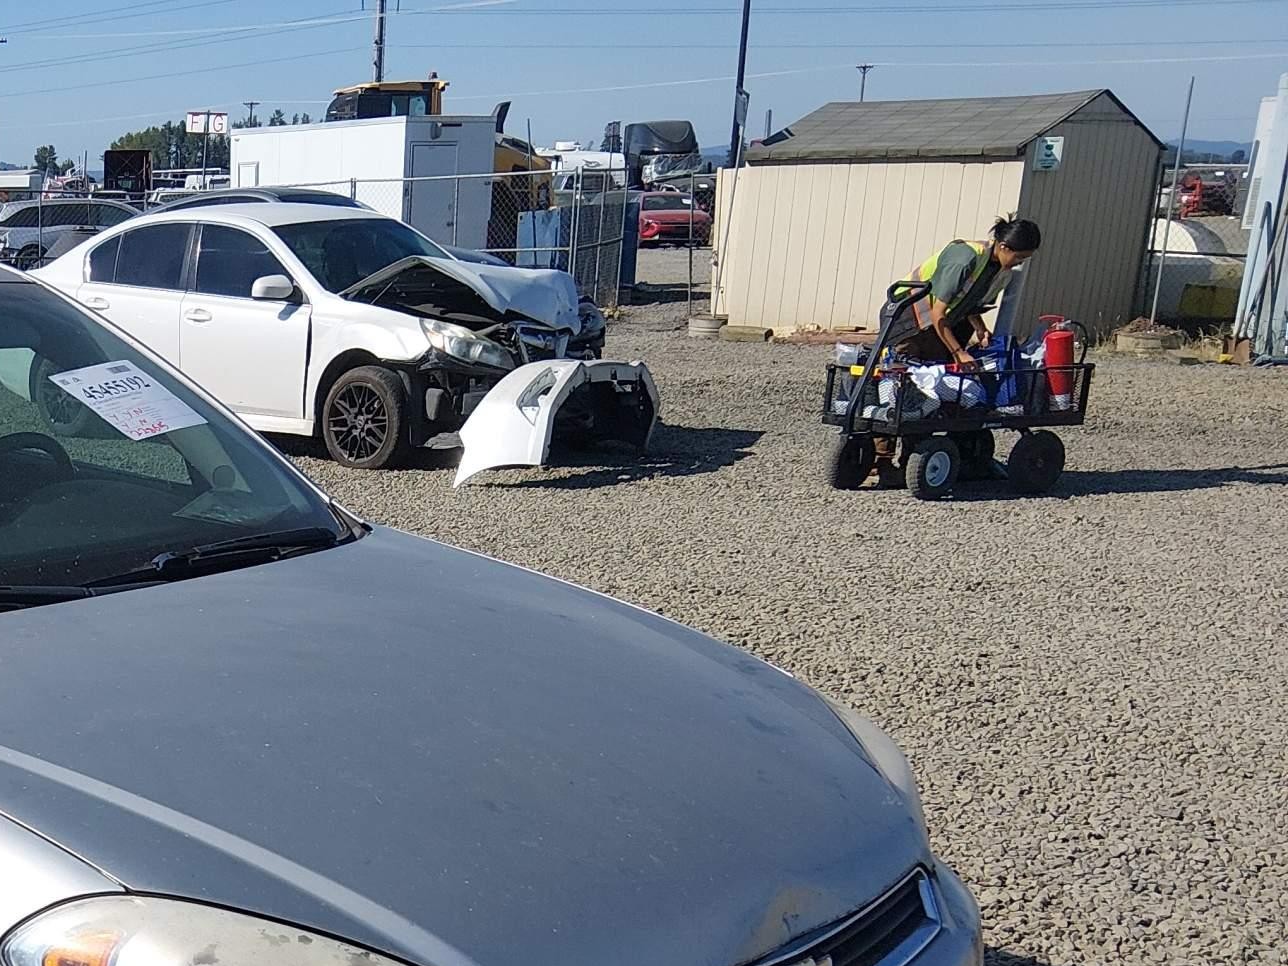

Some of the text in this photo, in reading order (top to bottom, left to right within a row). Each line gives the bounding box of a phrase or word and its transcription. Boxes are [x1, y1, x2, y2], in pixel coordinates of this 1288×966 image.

[191, 113, 200, 131] F
[213, 113, 223, 132] G
[82, 375, 151, 400] 45455192
